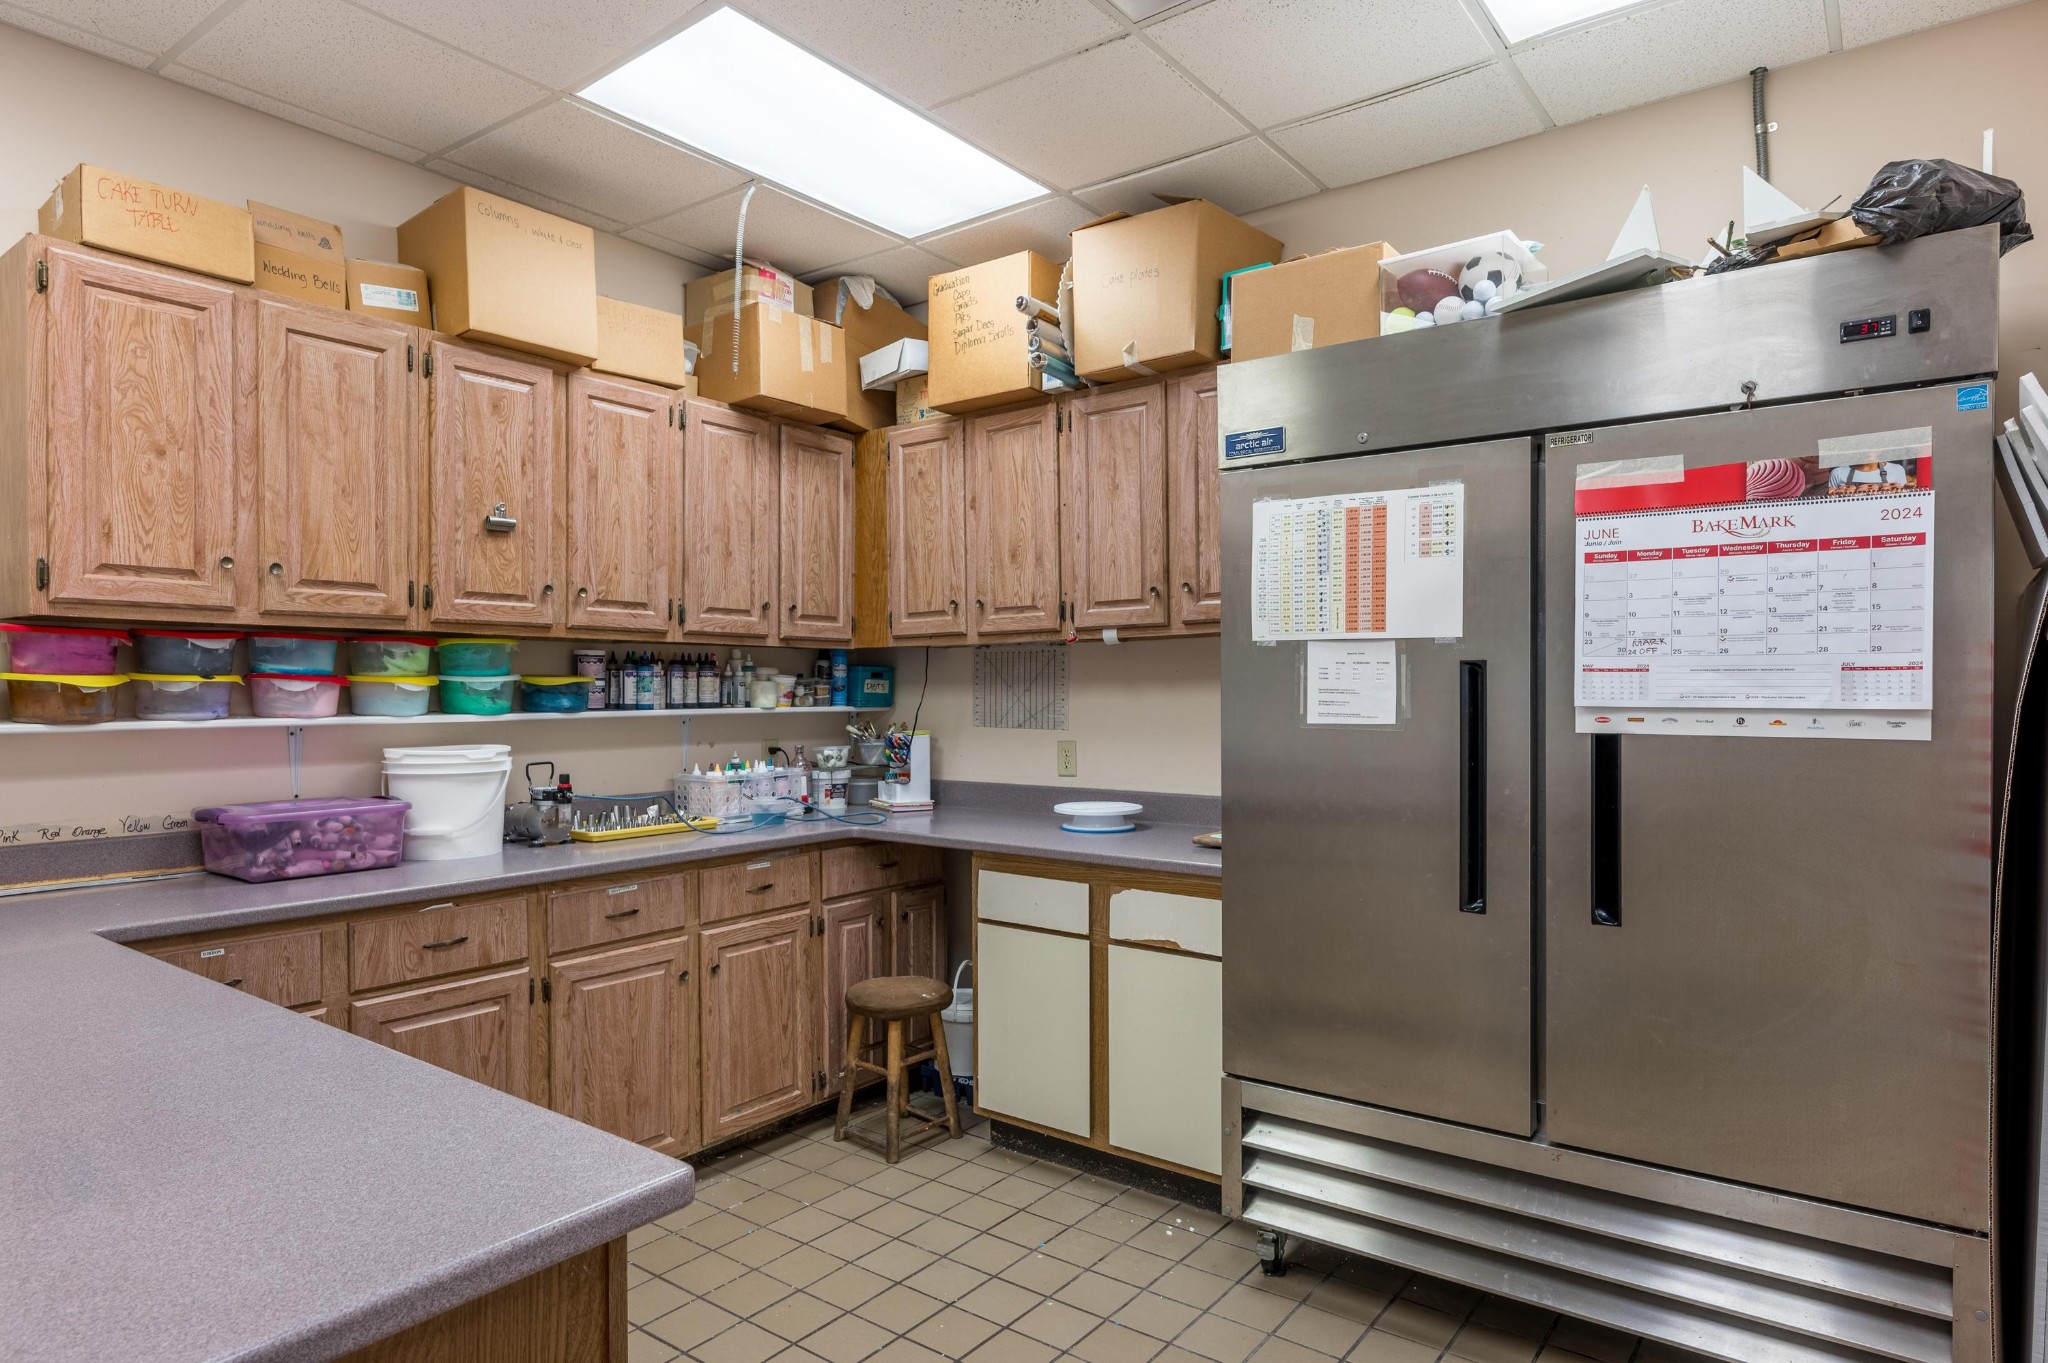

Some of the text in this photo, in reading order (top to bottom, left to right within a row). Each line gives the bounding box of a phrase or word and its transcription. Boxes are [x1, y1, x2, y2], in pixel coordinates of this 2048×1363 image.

[98, 177, 199, 217] CAKE TURN
[126, 209, 180, 234] TABLE
[262, 260, 341, 294] Wedding Bells
[933, 275, 970, 297] Graduation
[953, 288, 971, 301] Caps
[1860, 321, 1879, 335] 37
[953, 335, 987, 355] Diploma
[1235, 437, 1274, 450] arctic air
[1550, 433, 1592, 446] REFRIGERATOR
[1880, 506, 1923, 521] 2024
[1584, 528, 1620, 540] JUNE
[1881, 535, 1917, 543] Saturday
[1722, 544, 1764, 552] Wednesday
[1775, 541, 1810, 549] Thursday
[1832, 538, 1857, 547] Friday
[1632, 638, 1667, 647] MARK
[1639, 647, 1658, 655] OFF
[37, 828, 61, 840] Red
[72, 826, 108, 838] Orange
[119, 815, 150, 833] Yellow
[162, 814, 188, 830] Green
